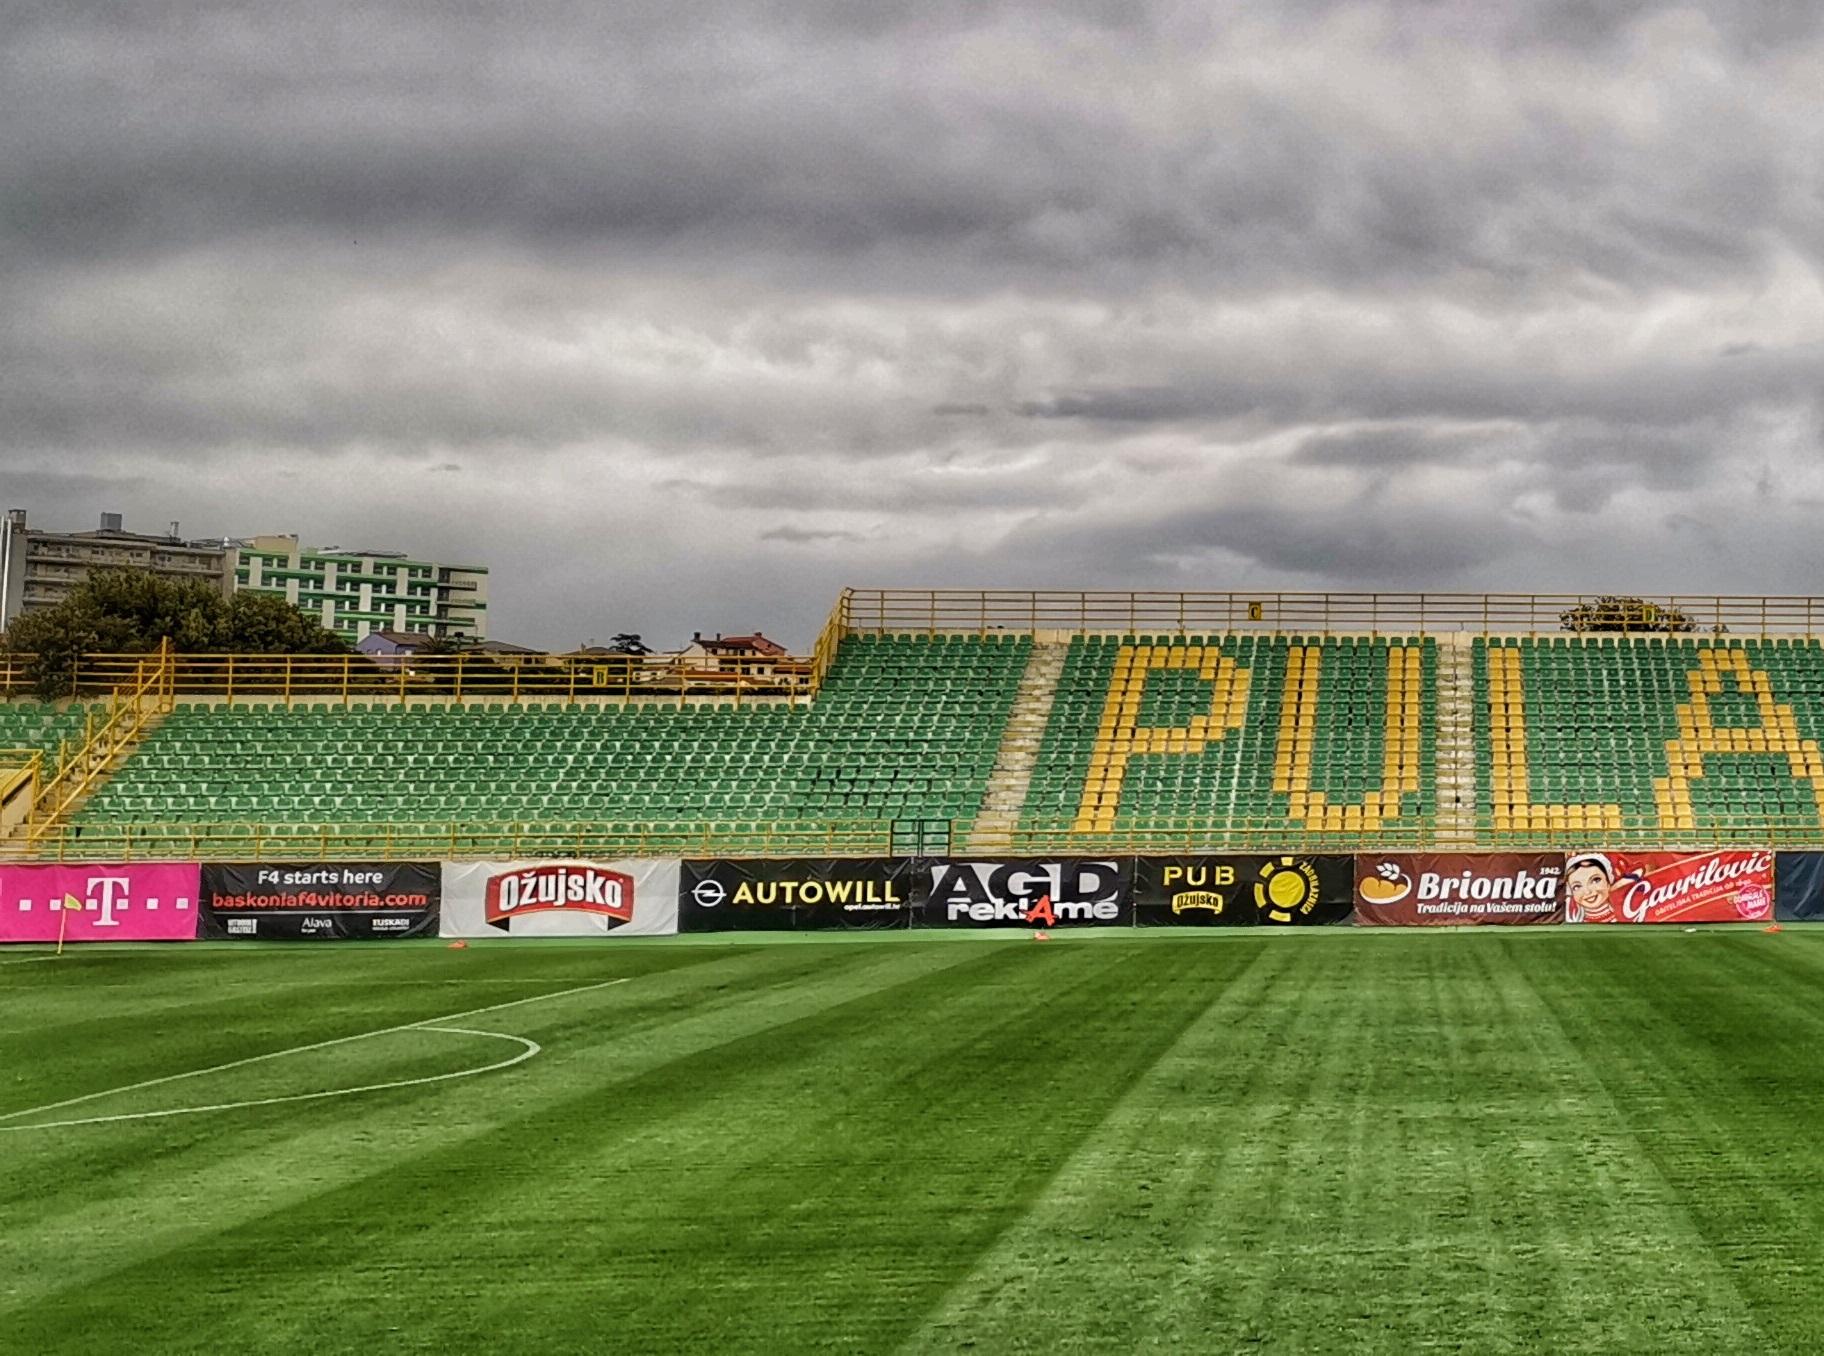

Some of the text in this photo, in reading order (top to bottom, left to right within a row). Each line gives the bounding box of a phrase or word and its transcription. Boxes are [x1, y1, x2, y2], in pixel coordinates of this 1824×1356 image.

[258, 869, 383, 885] F4 starts here
[500, 868, 623, 911] Ožujsko
[930, 862, 1119, 902] AGD
[1163, 866, 1235, 886] PUB
[1417, 870, 1557, 900] Brionka
[1622, 850, 1772, 922] Gavrilović
[87, 878, 129, 926] T
[212, 891, 427, 907] baskoniaf4vitoria.com
[732, 880, 901, 904] AUTOWILL
[1417, 902, 1557, 915] Tradicija na Vašem stolu!
